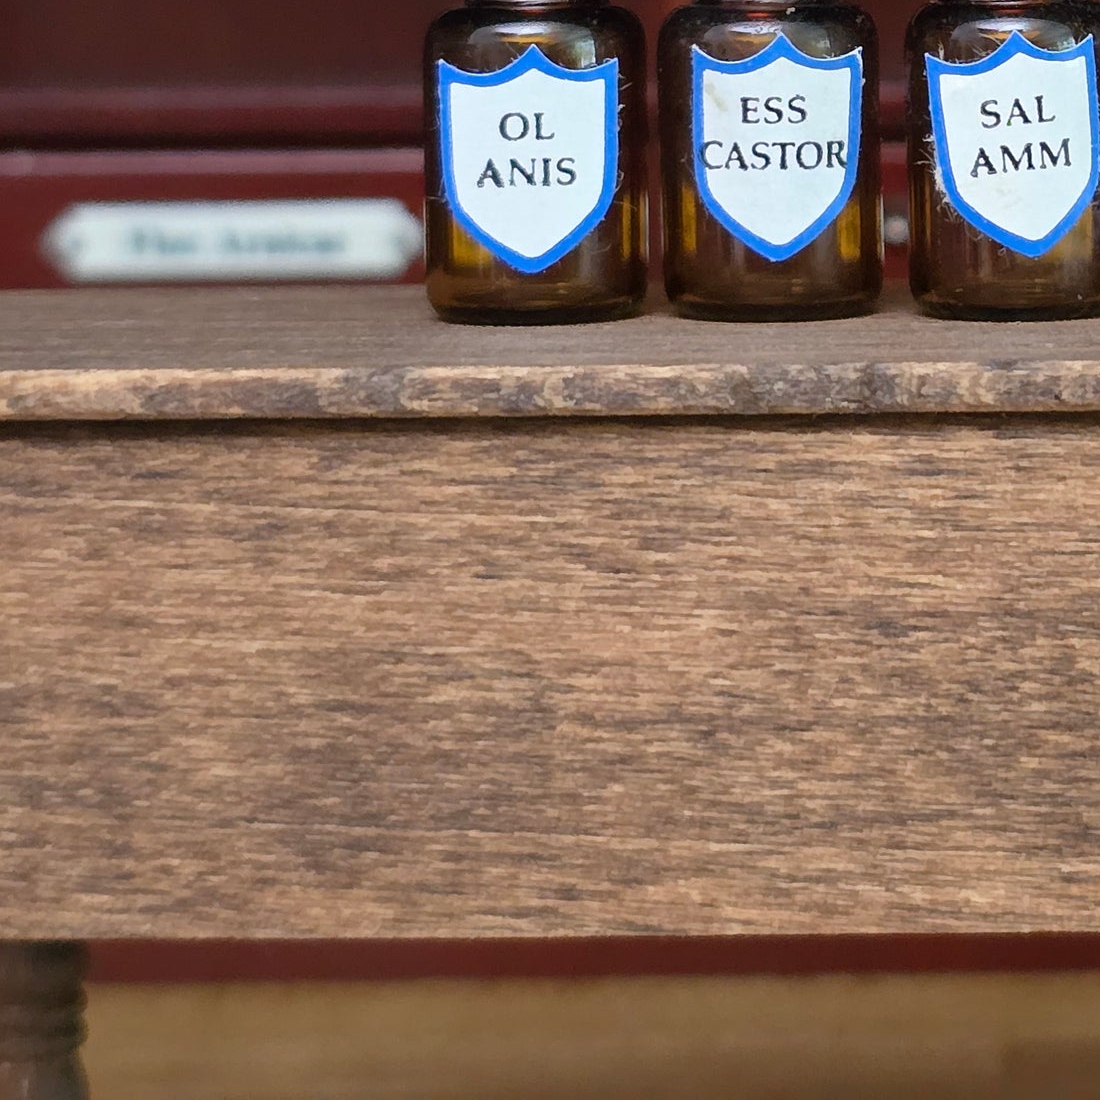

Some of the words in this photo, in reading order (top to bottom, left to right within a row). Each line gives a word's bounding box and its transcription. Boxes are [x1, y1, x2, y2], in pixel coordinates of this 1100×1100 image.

[740, 96, 807, 125] ESS
[980, 95, 1056, 129] SAL
[499, 112, 555, 141] OL
[700, 139, 848, 171] CASTOR
[970, 138, 1072, 178] AMM
[476, 157, 577, 187] ANIS
